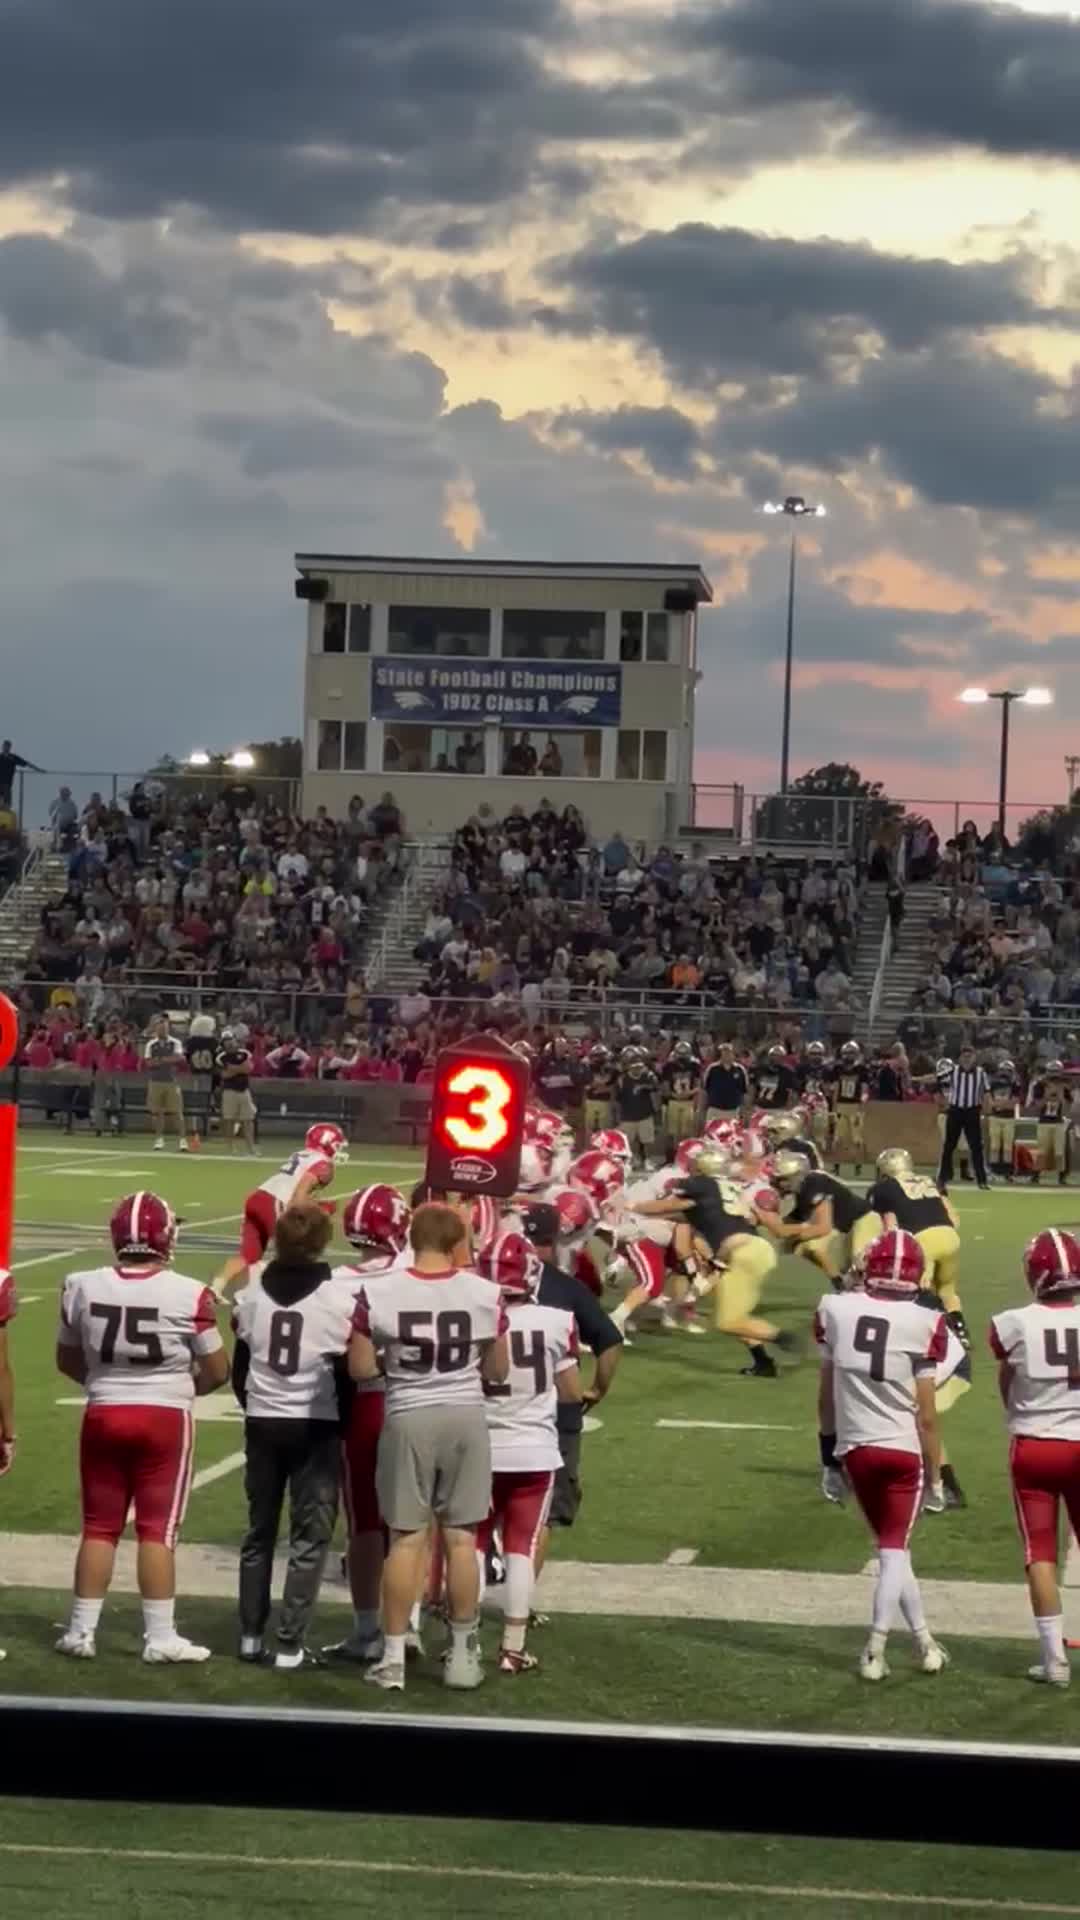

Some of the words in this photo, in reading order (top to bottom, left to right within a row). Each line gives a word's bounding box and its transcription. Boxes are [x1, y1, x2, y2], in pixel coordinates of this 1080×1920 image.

[376, 669, 425, 687] State
[430, 670, 506, 689] Football
[511, 671, 617, 692] Champions
[485, 693, 535, 713] Class
[537, 694, 549, 713] A
[445, 1066, 511, 1152] 3
[90, 1303, 163, 1366] 75
[267, 1311, 304, 1377] 8
[397, 1310, 472, 1375] 58
[853, 1315, 890, 1382] 9
[1044, 1328, 1079, 1391] 4
